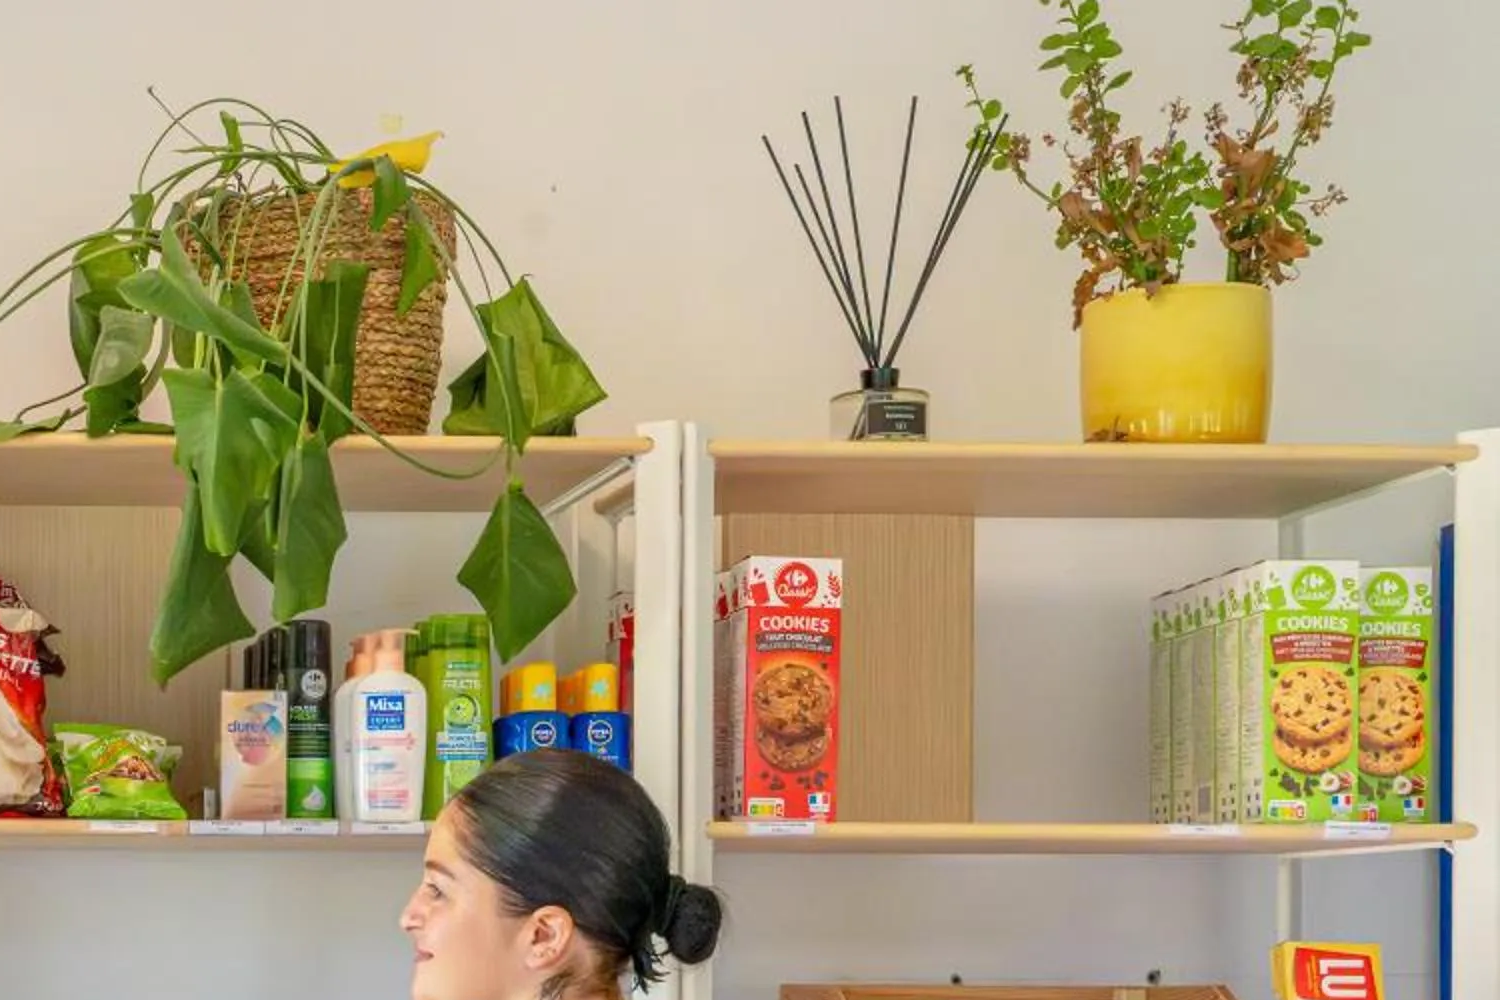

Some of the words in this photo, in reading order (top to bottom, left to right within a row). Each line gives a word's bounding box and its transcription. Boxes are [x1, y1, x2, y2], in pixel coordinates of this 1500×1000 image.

[760, 615, 830, 633] COOKIES
[1278, 615, 1348, 631] COOKIES
[1361, 621, 1421, 637] OOKIES
[369, 697, 403, 711] Mixa
[228, 719, 268, 733] durex
[1319, 958, 1368, 998] LU
